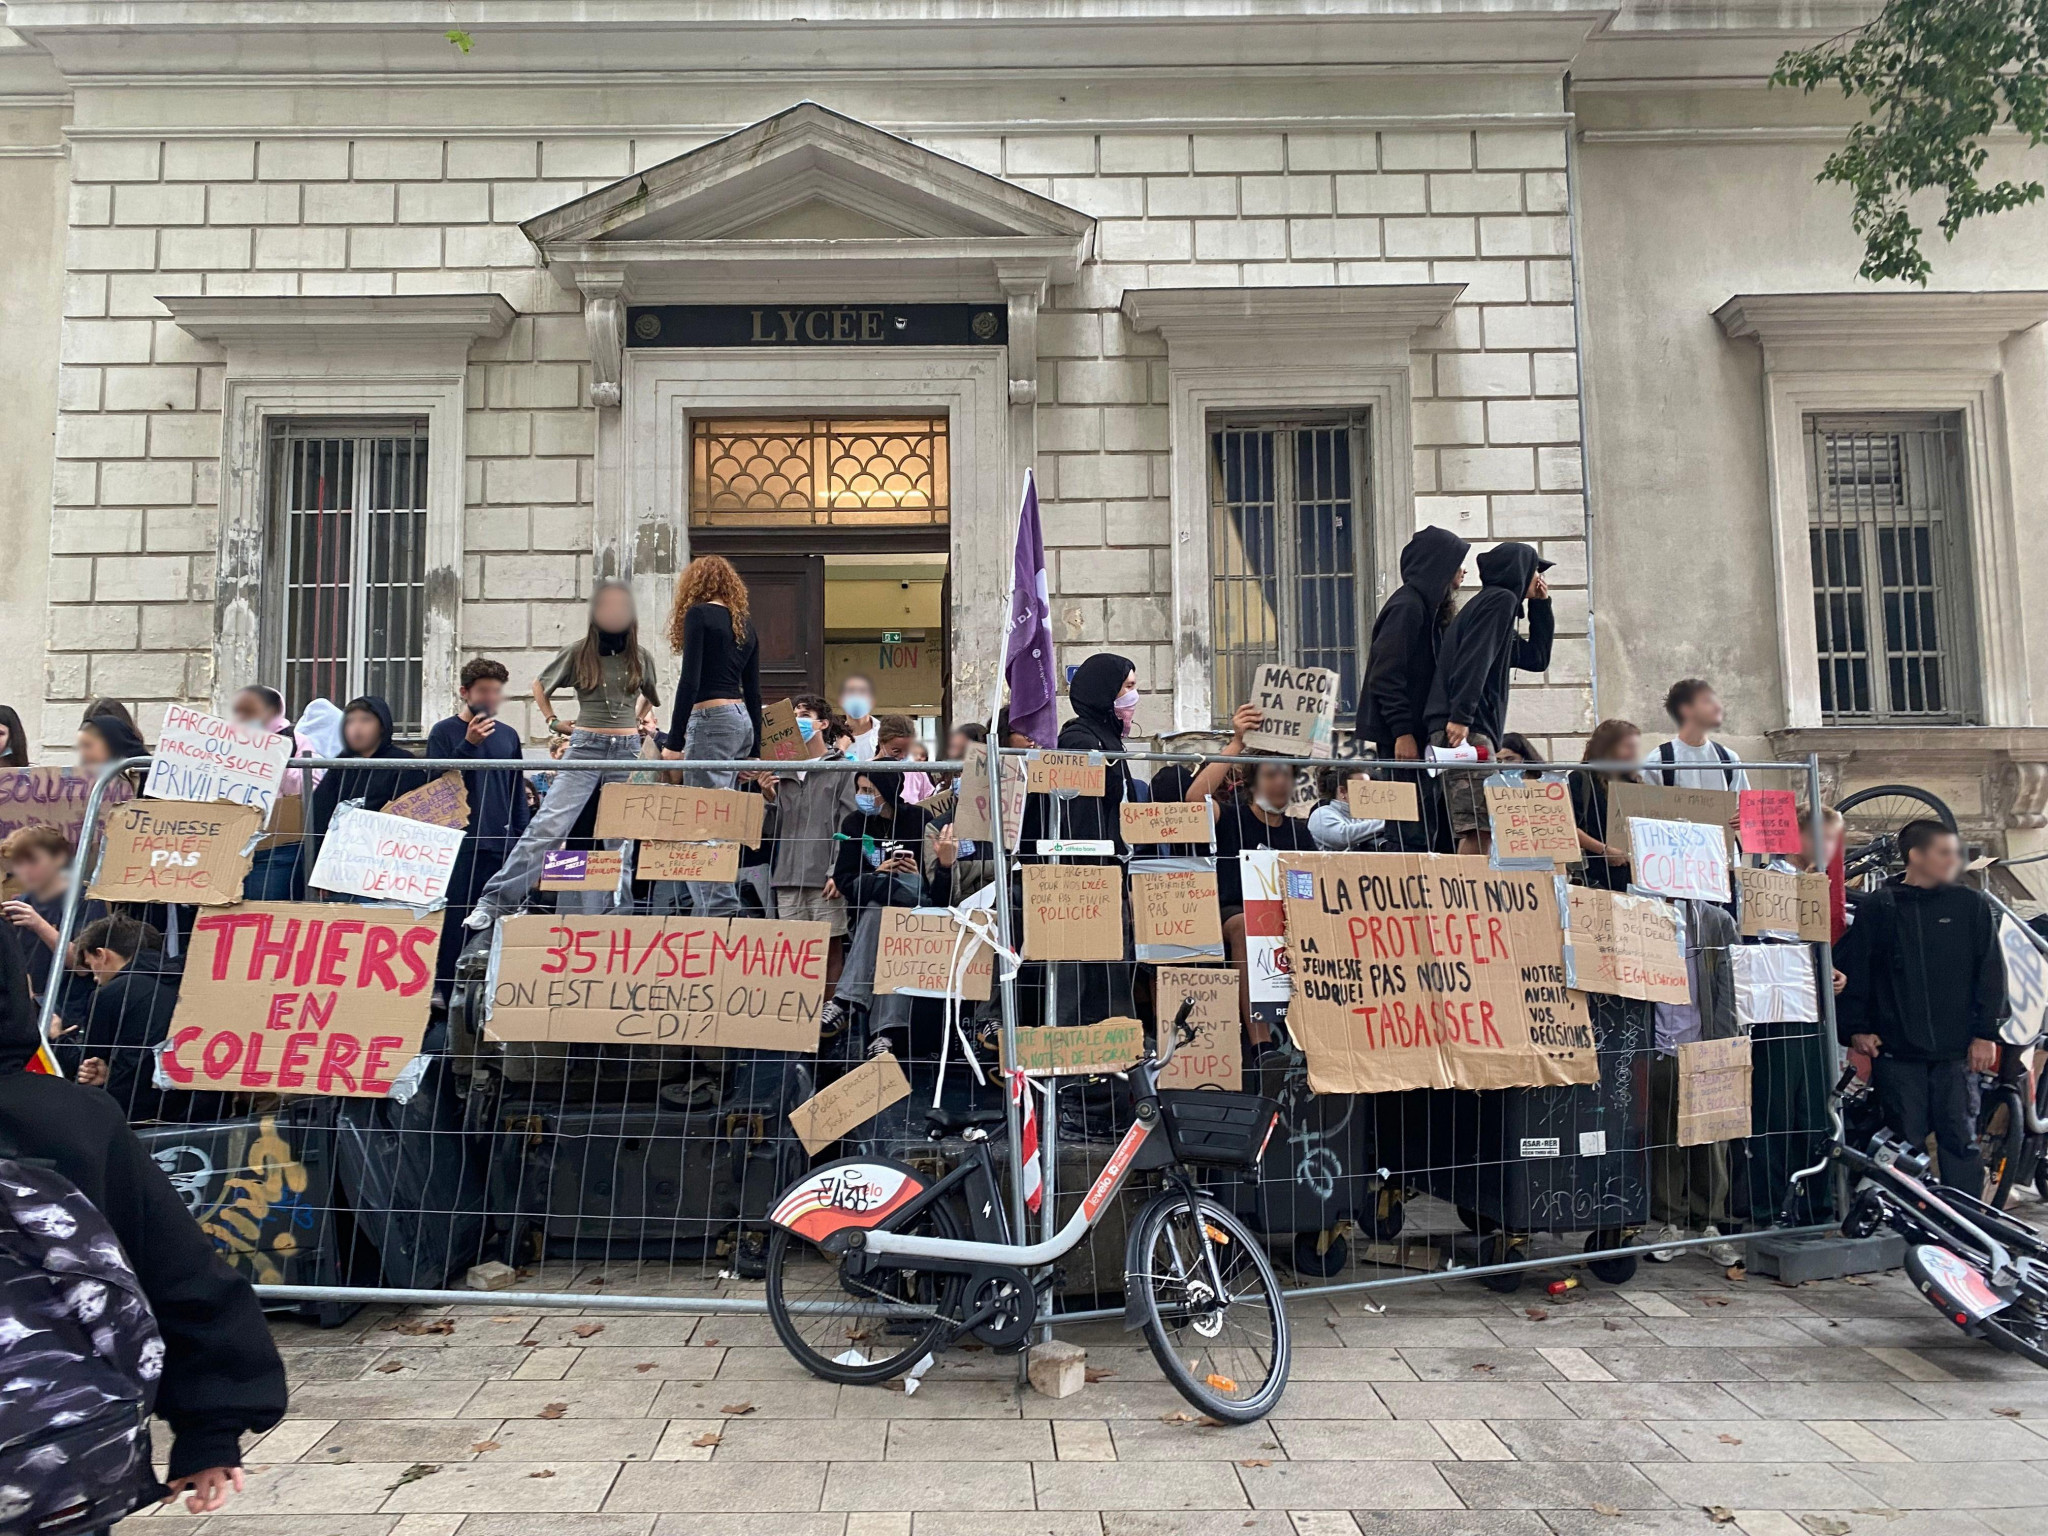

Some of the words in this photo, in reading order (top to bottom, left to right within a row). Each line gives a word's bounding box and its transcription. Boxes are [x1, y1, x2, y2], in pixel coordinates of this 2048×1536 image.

[750, 305, 885, 342] LYCÉE
[879, 645, 919, 669] NON
[1261, 692, 1284, 710] TA
[205, 738, 232, 756] OU
[1043, 753, 1085, 767] CONTRE
[1033, 771, 1043, 783] LE
[1492, 786, 1510, 801] LA
[623, 793, 686, 826] FREE
[1496, 805, 1528, 815] C'EST
[125, 808, 222, 837] JEUNESSE
[1188, 816, 1200, 824] LE
[1511, 814, 1570, 827] BAISER
[1161, 827, 1179, 838] BAC
[1505, 828, 1526, 838] PAS
[1532, 826, 1566, 837] POUR
[1636, 822, 1706, 847] THIERS
[132, 835, 212, 854] FACHÉE
[1509, 836, 1577, 854] RÉVISER
[151, 850, 202, 869] PAS
[1029, 866, 1047, 881] DE
[1642, 853, 1722, 891] COLÈRE
[362, 869, 443, 899] DÉVORE
[1040, 881, 1058, 891] POUR
[1320, 877, 1353, 914] LA
[1359, 875, 1432, 912] POLICE
[1440, 873, 1477, 912] DOIT
[1484, 880, 1539, 914] NOUS
[1031, 893, 1052, 905] POUR
[1175, 891, 1185, 899] UN
[1037, 903, 1102, 925] POLICIER
[1147, 902, 1168, 918] PAS
[1182, 903, 1198, 914] UN
[1743, 888, 1823, 926] RESPECTER
[1155, 919, 1195, 936] LUXE
[1581, 914, 1613, 932] QUE
[884, 936, 958, 957] PARTOUT
[1301, 937, 1319, 954] LA
[1348, 913, 1509, 965] PROTEGER
[197, 913, 438, 997] THIERS
[881, 960, 946, 979] JUSTICE
[955, 962, 992, 975] ULLE
[1303, 957, 1363, 982] JEUNESSE
[1521, 965, 1563, 984] NOTRE
[1370, 964, 1406, 998] PAS
[1417, 961, 1472, 993] NOUS
[496, 980, 536, 1007] ON
[548, 979, 604, 1010] EST
[778, 991, 822, 1024] EN
[1304, 979, 1364, 1007] BLOQUE!
[266, 991, 337, 1030] EN
[1529, 1007, 1555, 1023] VOS
[1352, 1000, 1504, 1051] TABASSER
[1530, 1022, 1592, 1050] DECISIONS
[161, 1026, 404, 1093] COLERE
[1072, 1050, 1085, 1065] DE
[1168, 1055, 1233, 1079] STUPS
